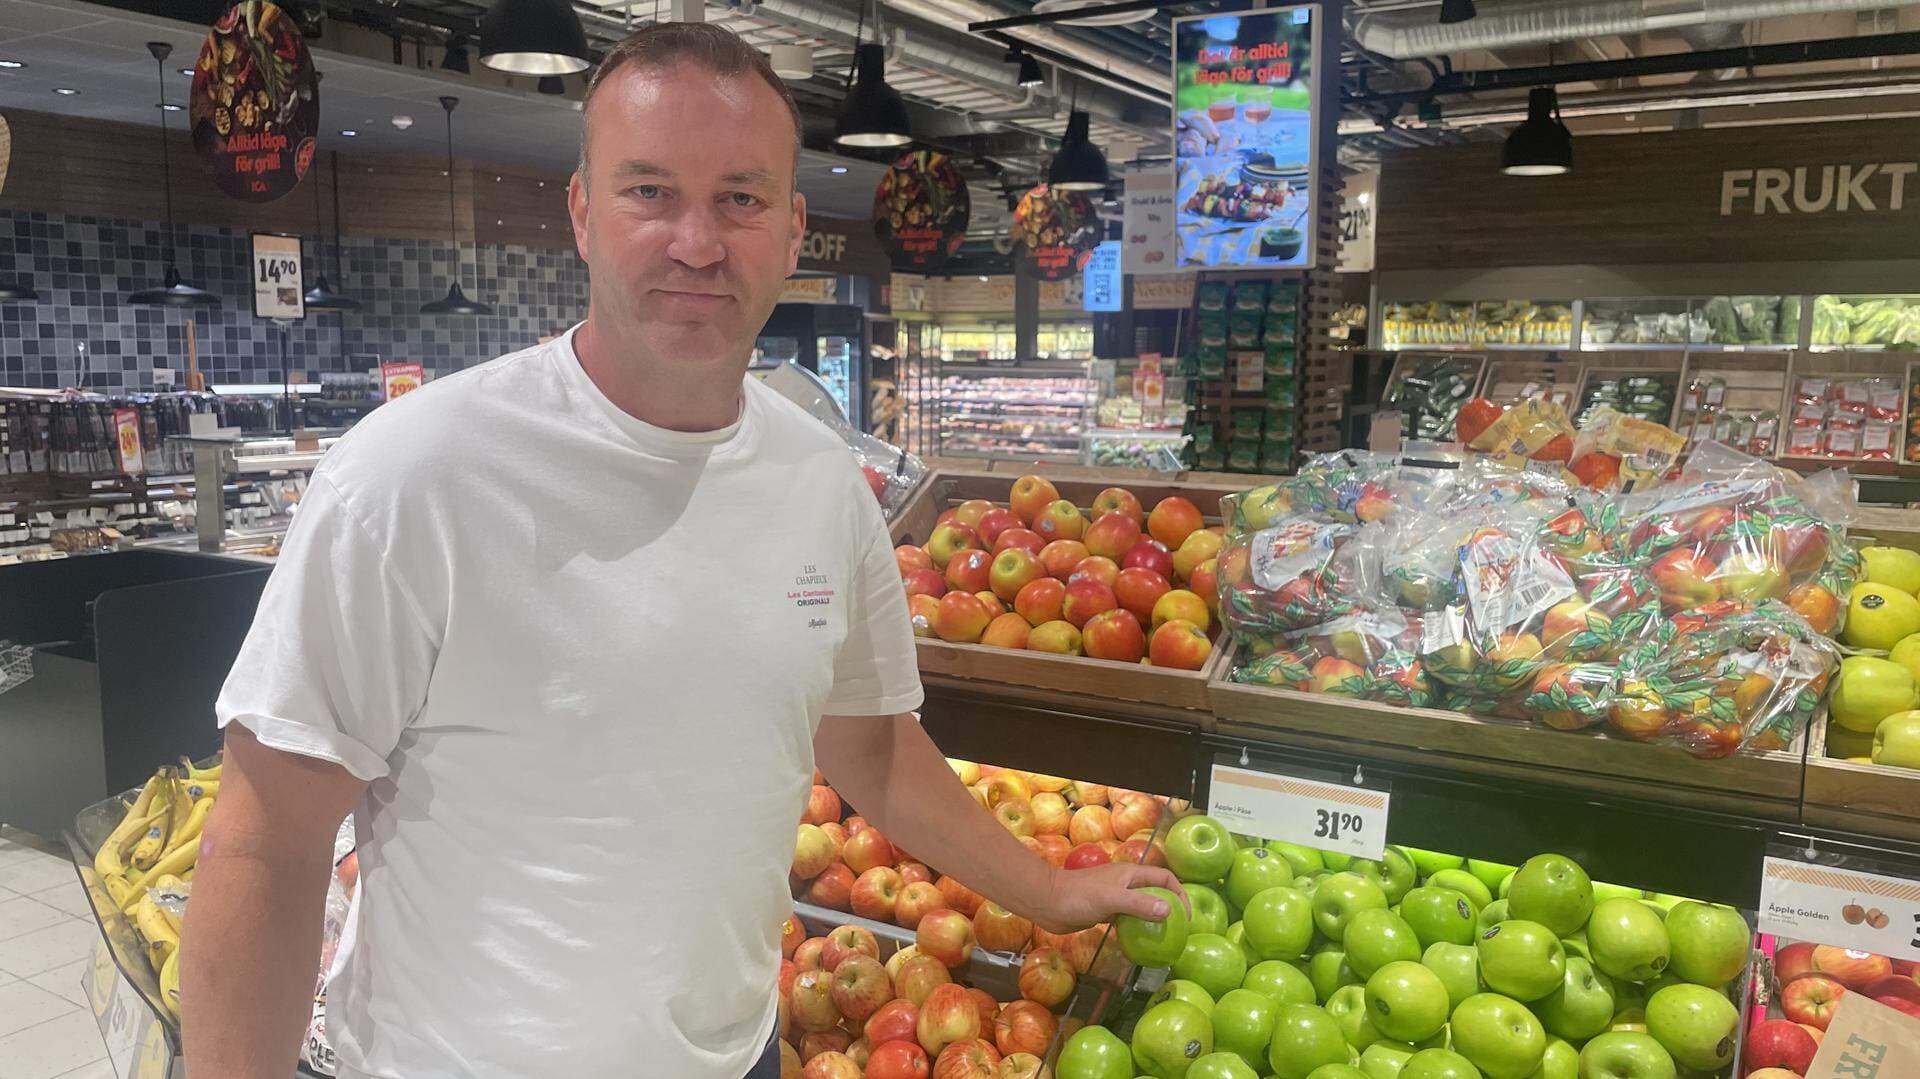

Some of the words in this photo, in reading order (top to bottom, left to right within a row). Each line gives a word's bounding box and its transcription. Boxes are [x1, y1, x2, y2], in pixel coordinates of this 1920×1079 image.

[1248, 42, 1288, 60] alltid
[1231, 66, 1253, 82] för
[227, 133, 259, 153] Alltid
[235, 155, 252, 173] för
[1720, 162, 1918, 216] FRUKT
[804, 565, 817, 574] LES
[1768, 902, 1795, 914] Äpple
[1797, 908, 1830, 921] Golden
